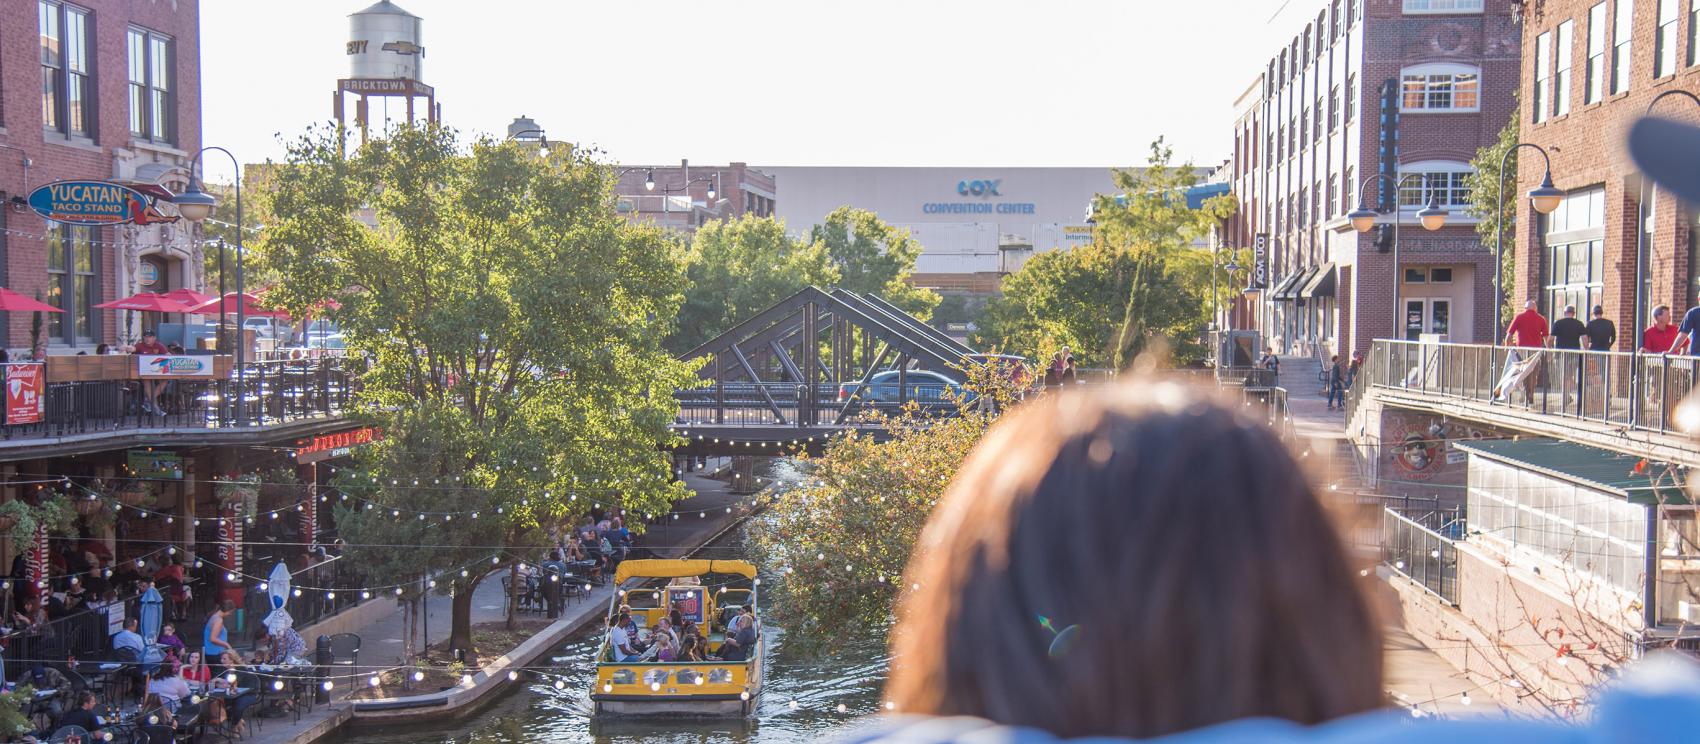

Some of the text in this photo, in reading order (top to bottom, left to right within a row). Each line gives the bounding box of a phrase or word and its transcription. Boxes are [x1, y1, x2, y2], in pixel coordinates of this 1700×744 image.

[343, 80, 406, 91] BRICKTOWN
[50, 185, 122, 203] YUCATAN
[957, 178, 1003, 197] COX
[51, 202, 122, 213] TACO STAND
[923, 202, 1035, 215] CONVENTION CENTER
[218, 518, 234, 560] Coffee
[24, 541, 41, 583] Coffee
